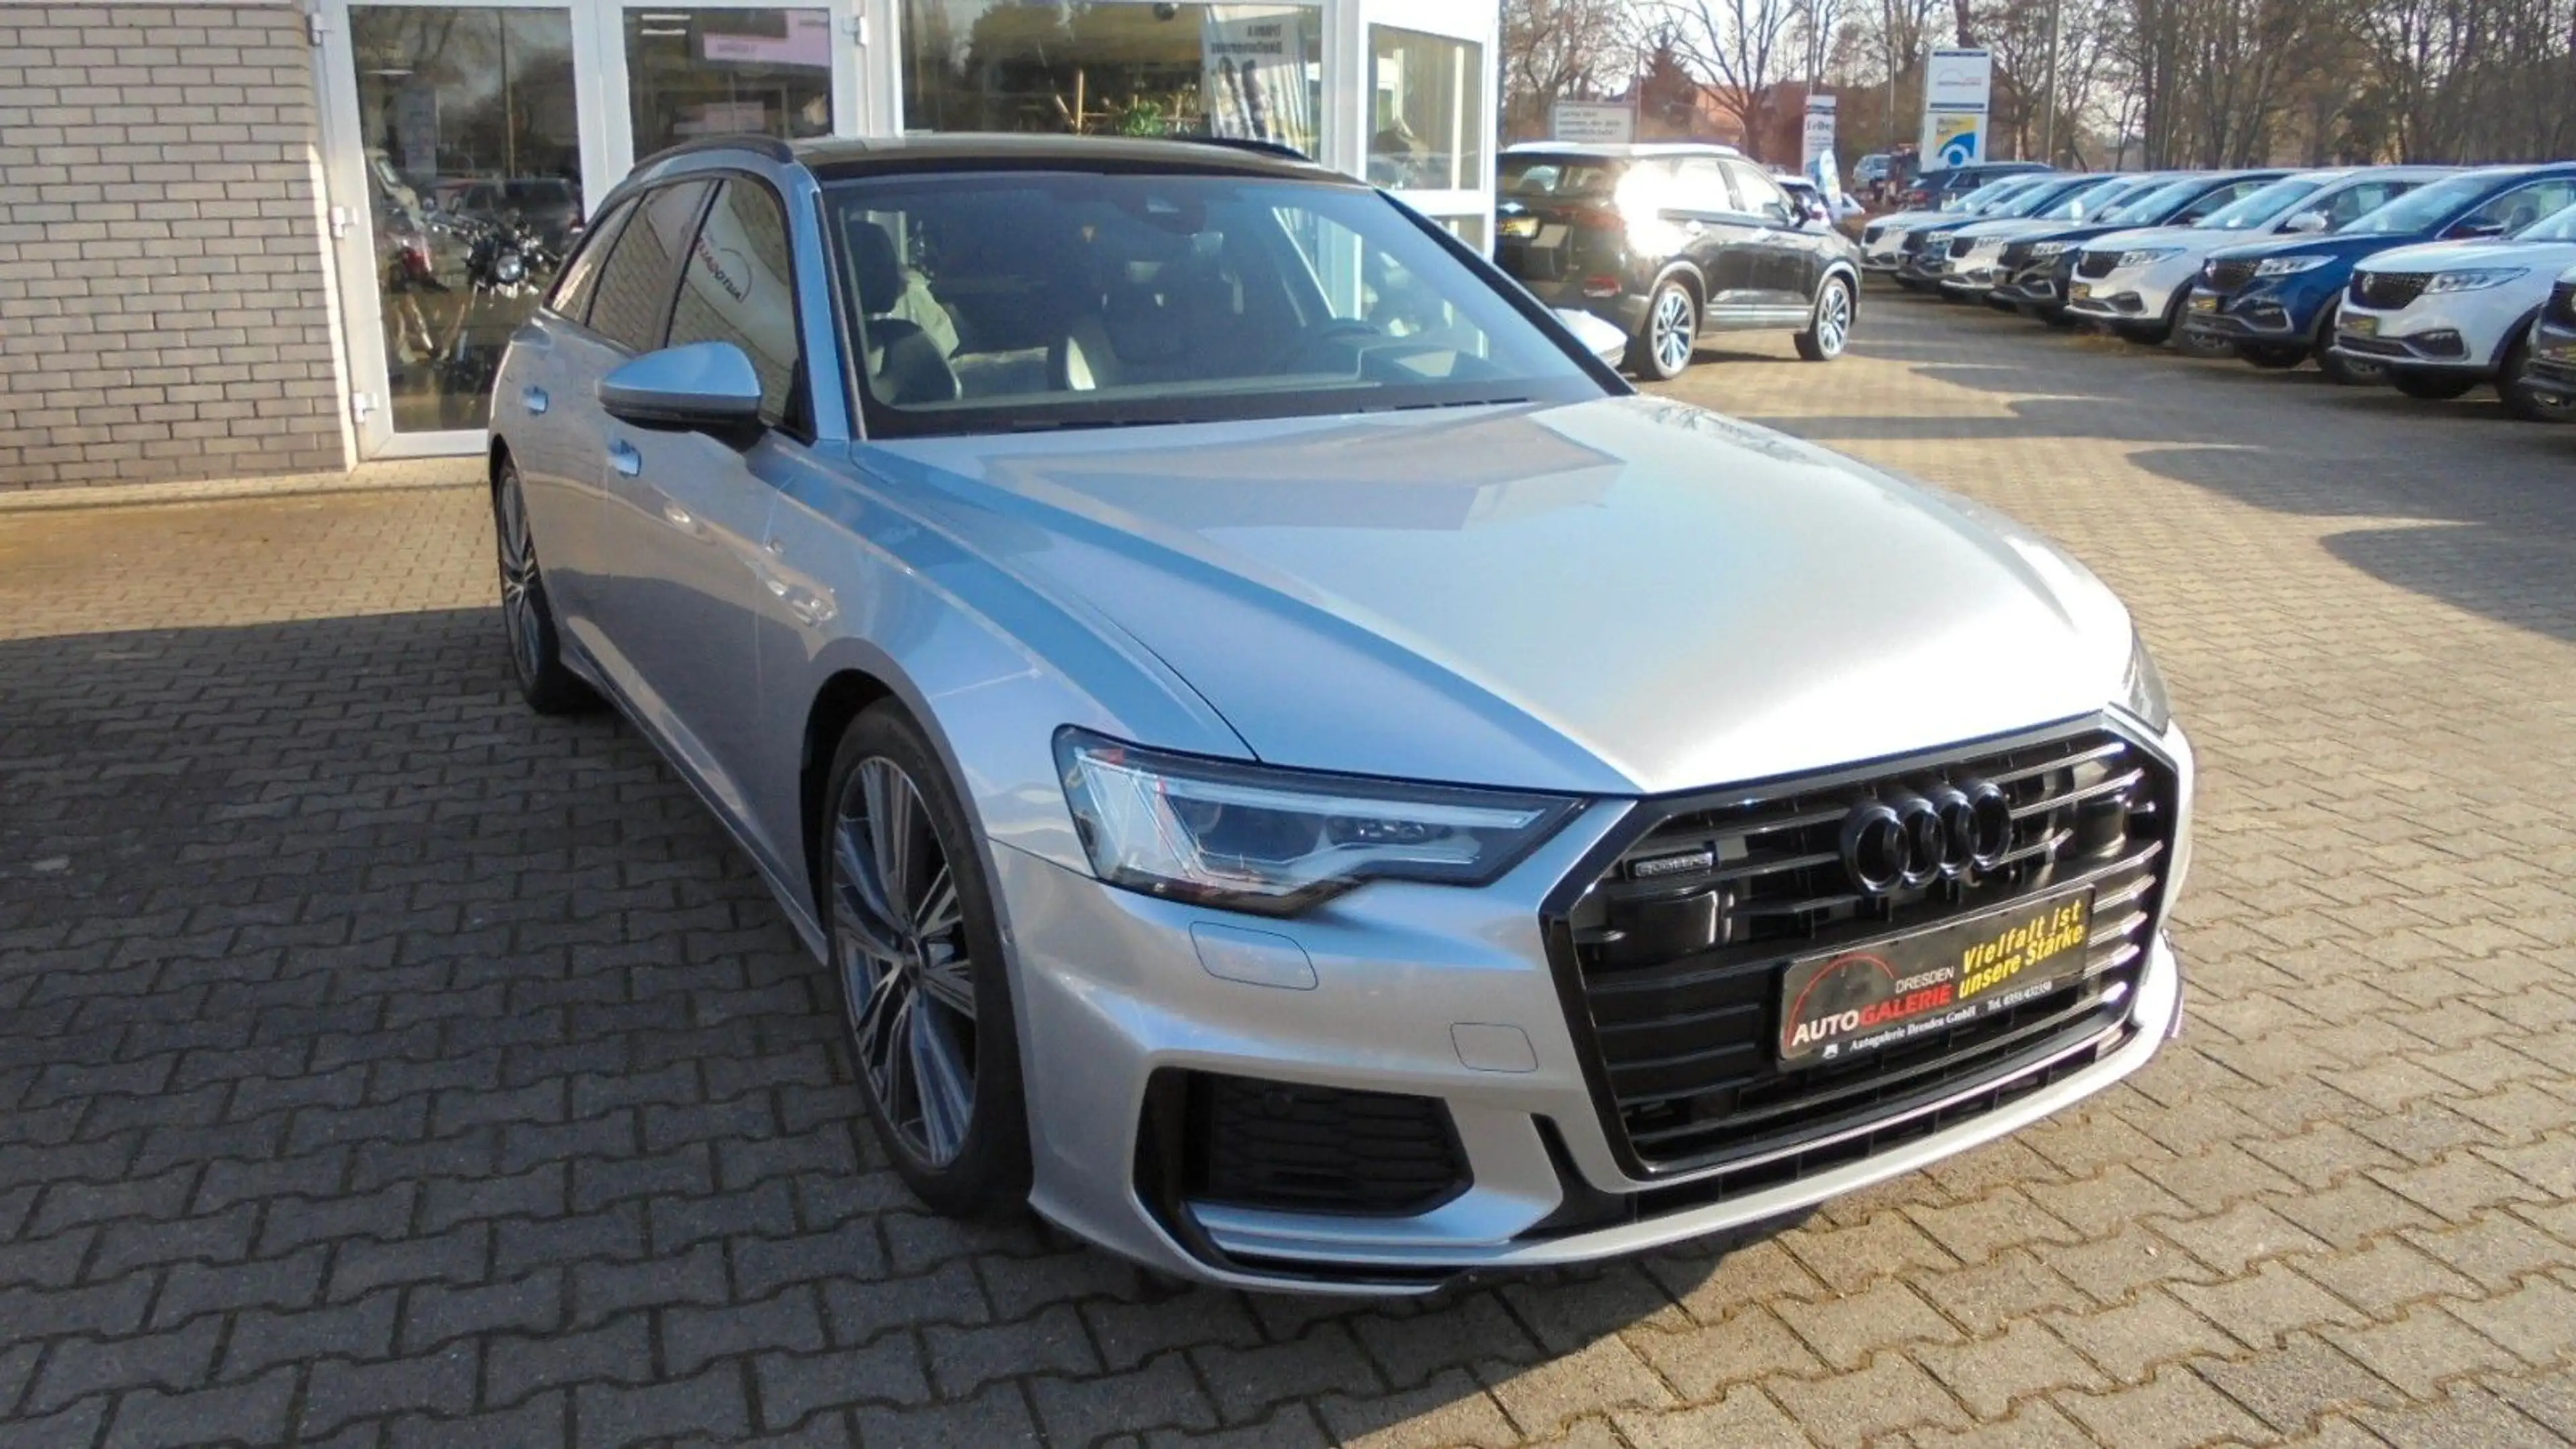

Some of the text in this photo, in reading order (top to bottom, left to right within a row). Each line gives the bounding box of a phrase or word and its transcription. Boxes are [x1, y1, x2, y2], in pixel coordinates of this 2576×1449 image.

[1964, 899, 2082, 973] Vielfalt ist
[1894, 966, 1955, 994] DRESDEN
[1958, 954, 2022, 999] unsere
[1791, 983, 1953, 1046] AUTOGALERIE
[1849, 1004, 1977, 1053] Autogalerie Dresden GmbH
